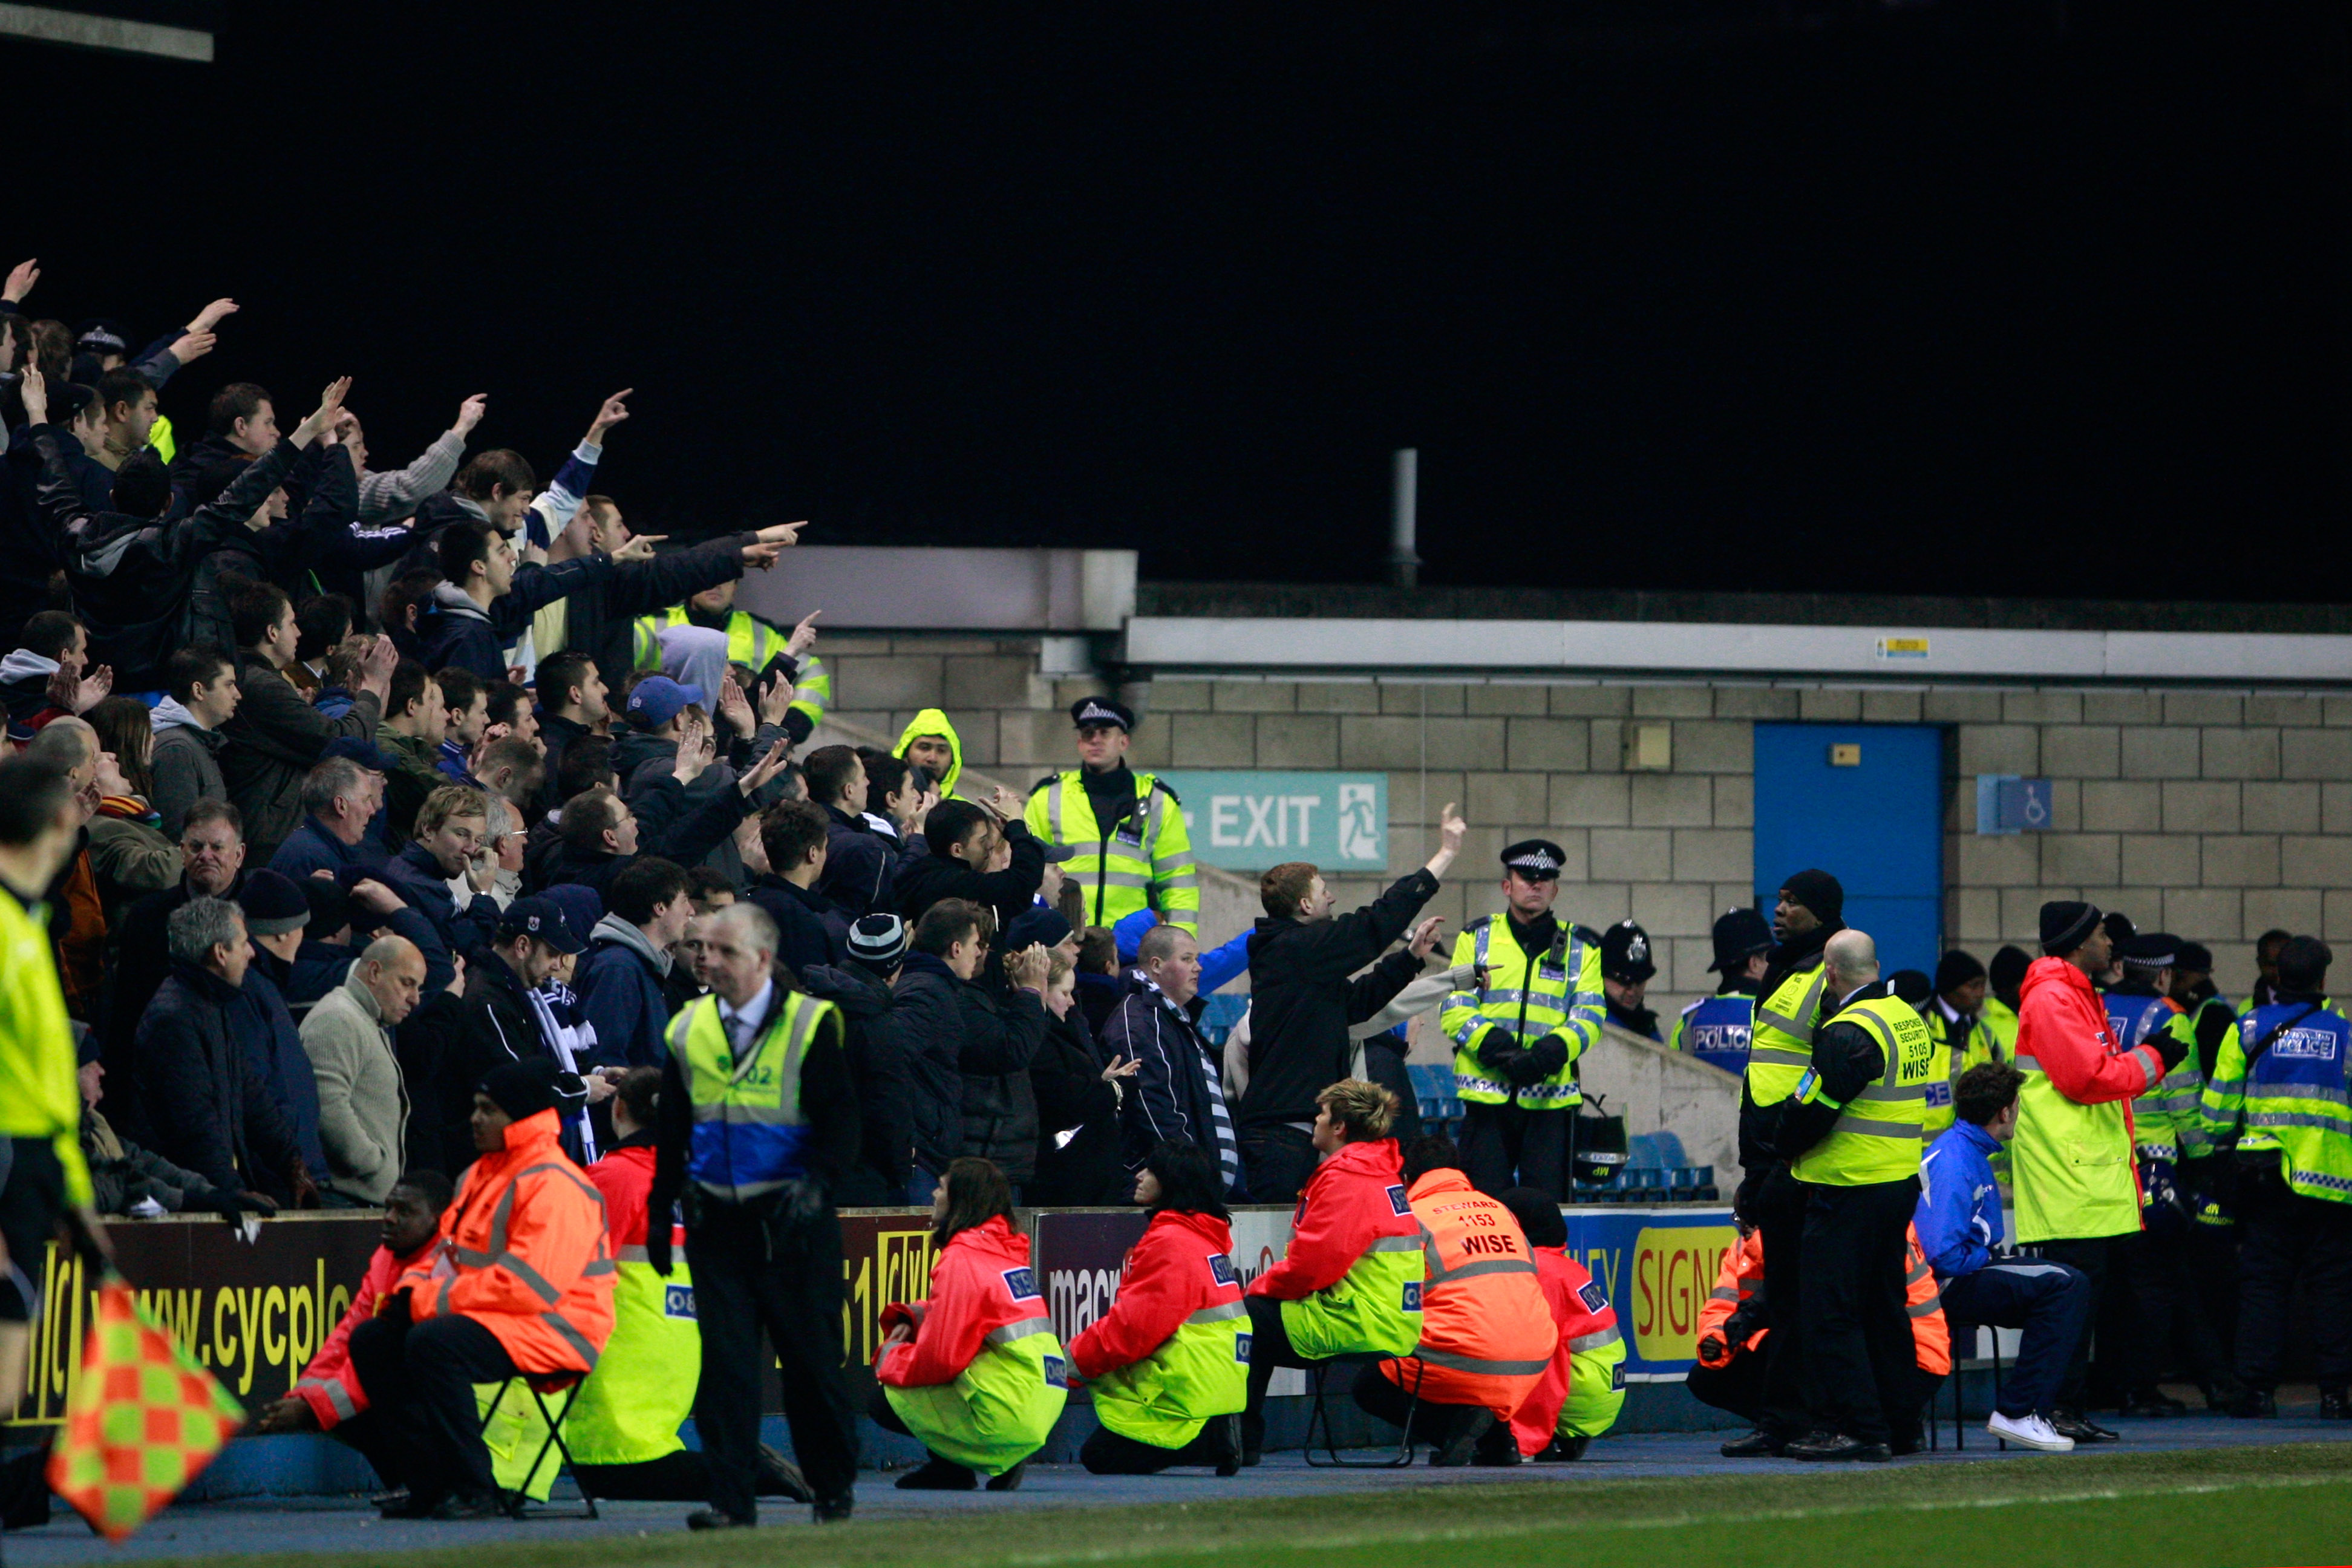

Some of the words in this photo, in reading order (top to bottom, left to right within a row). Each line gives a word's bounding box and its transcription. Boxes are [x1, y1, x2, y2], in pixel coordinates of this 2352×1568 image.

[1211, 795, 1321, 846] EXIT
[1893, 1018, 1923, 1032] RESPONSE
[1900, 1029, 1927, 1044] SECURITY
[1909, 1042, 1927, 1057] 5105
[2278, 1038, 2330, 1056] POLICE
[1432, 1201, 1498, 1215] STEWARD
[1459, 1214, 1496, 1227] 1153
[1460, 1235, 1517, 1255] WISE
[1639, 1247, 1729, 1336] SIGN
[1050, 1269, 1121, 1345] macr
